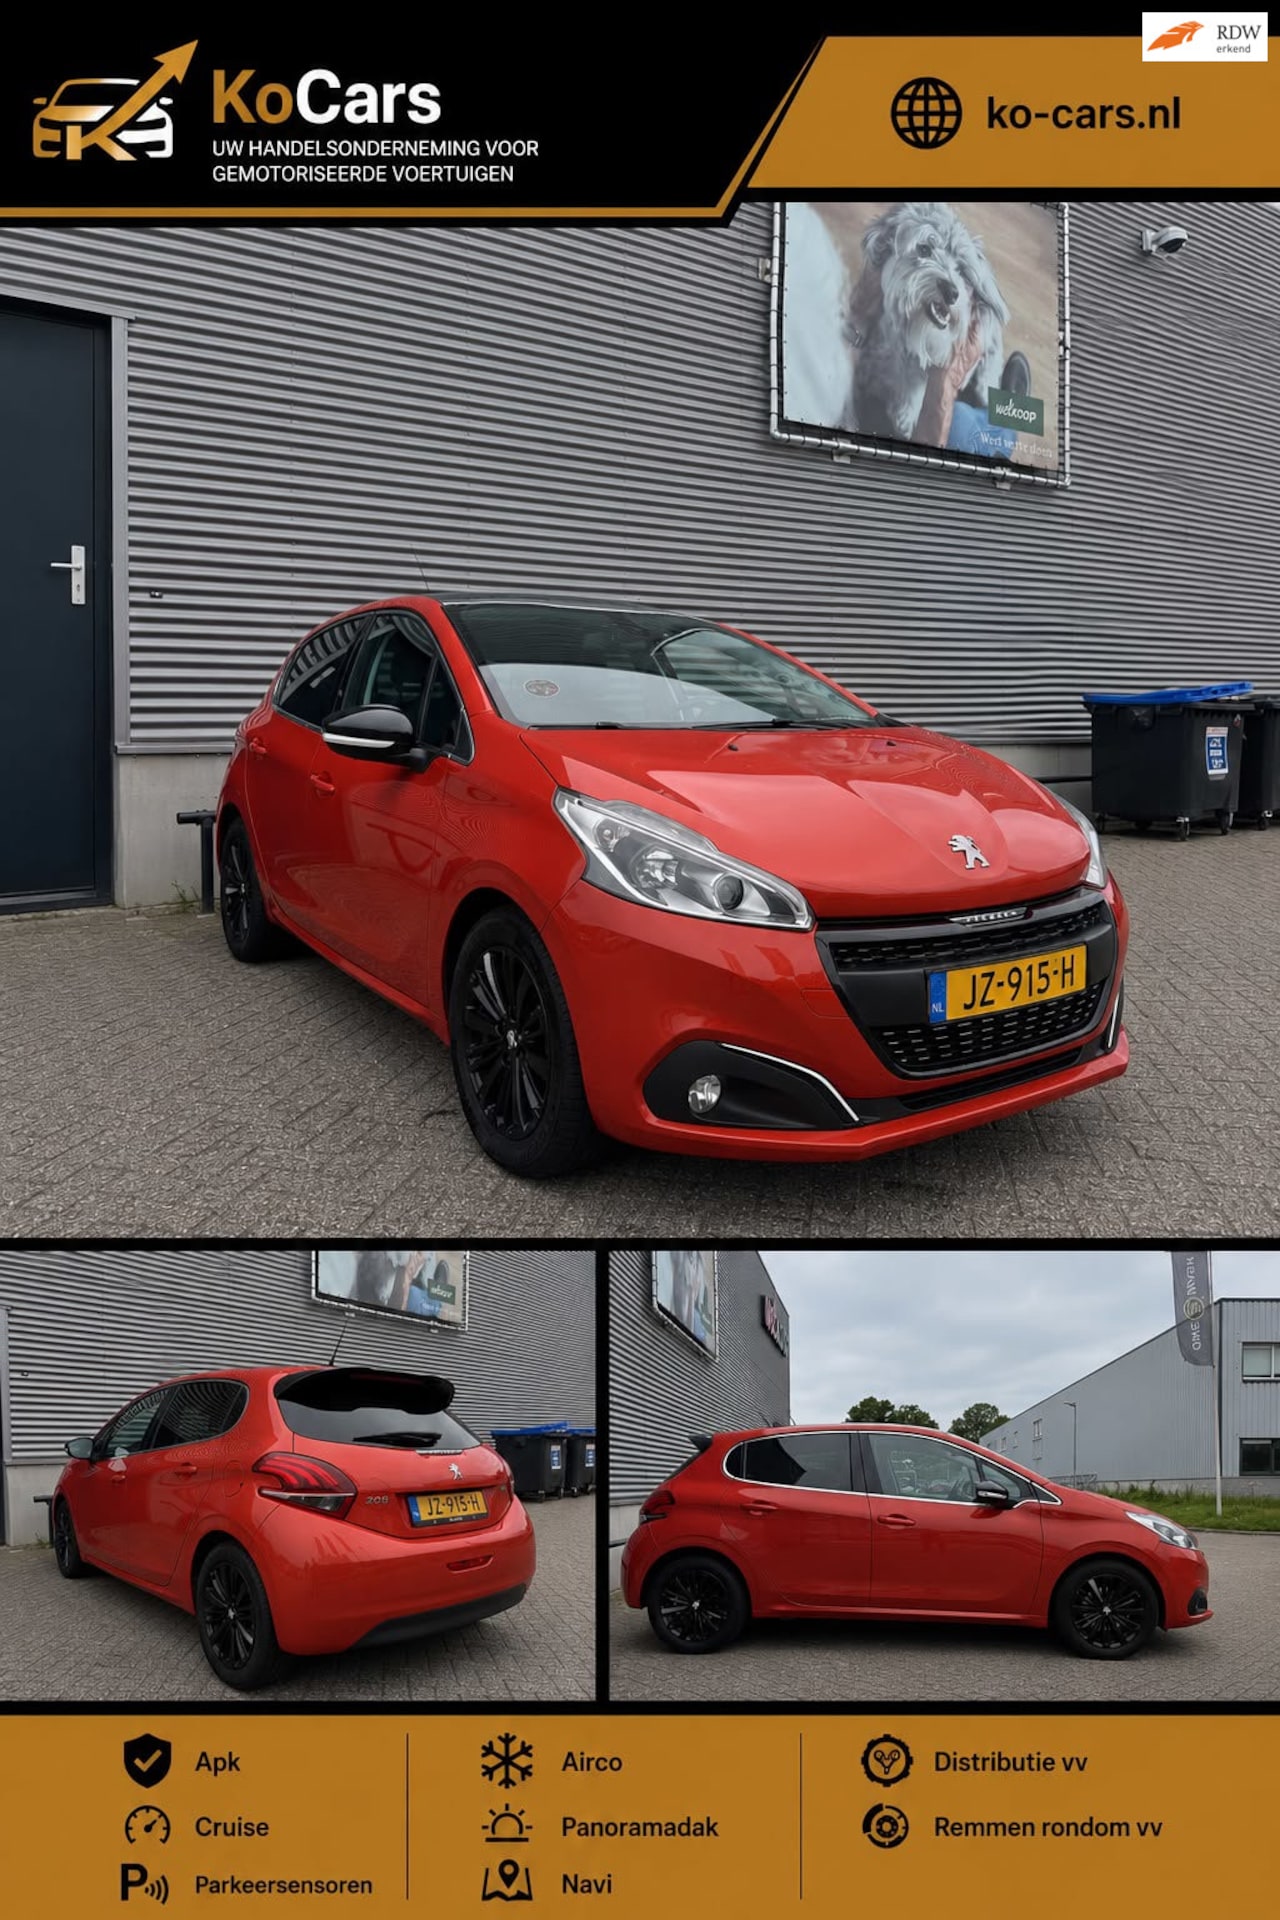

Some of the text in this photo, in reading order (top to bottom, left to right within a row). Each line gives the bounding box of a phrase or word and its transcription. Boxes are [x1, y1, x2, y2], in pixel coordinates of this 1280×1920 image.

[963, 954, 1075, 1010] JZ-915-H
[931, 1003, 945, 1014] NL
[428, 1494, 481, 1516] JZ-915-H
